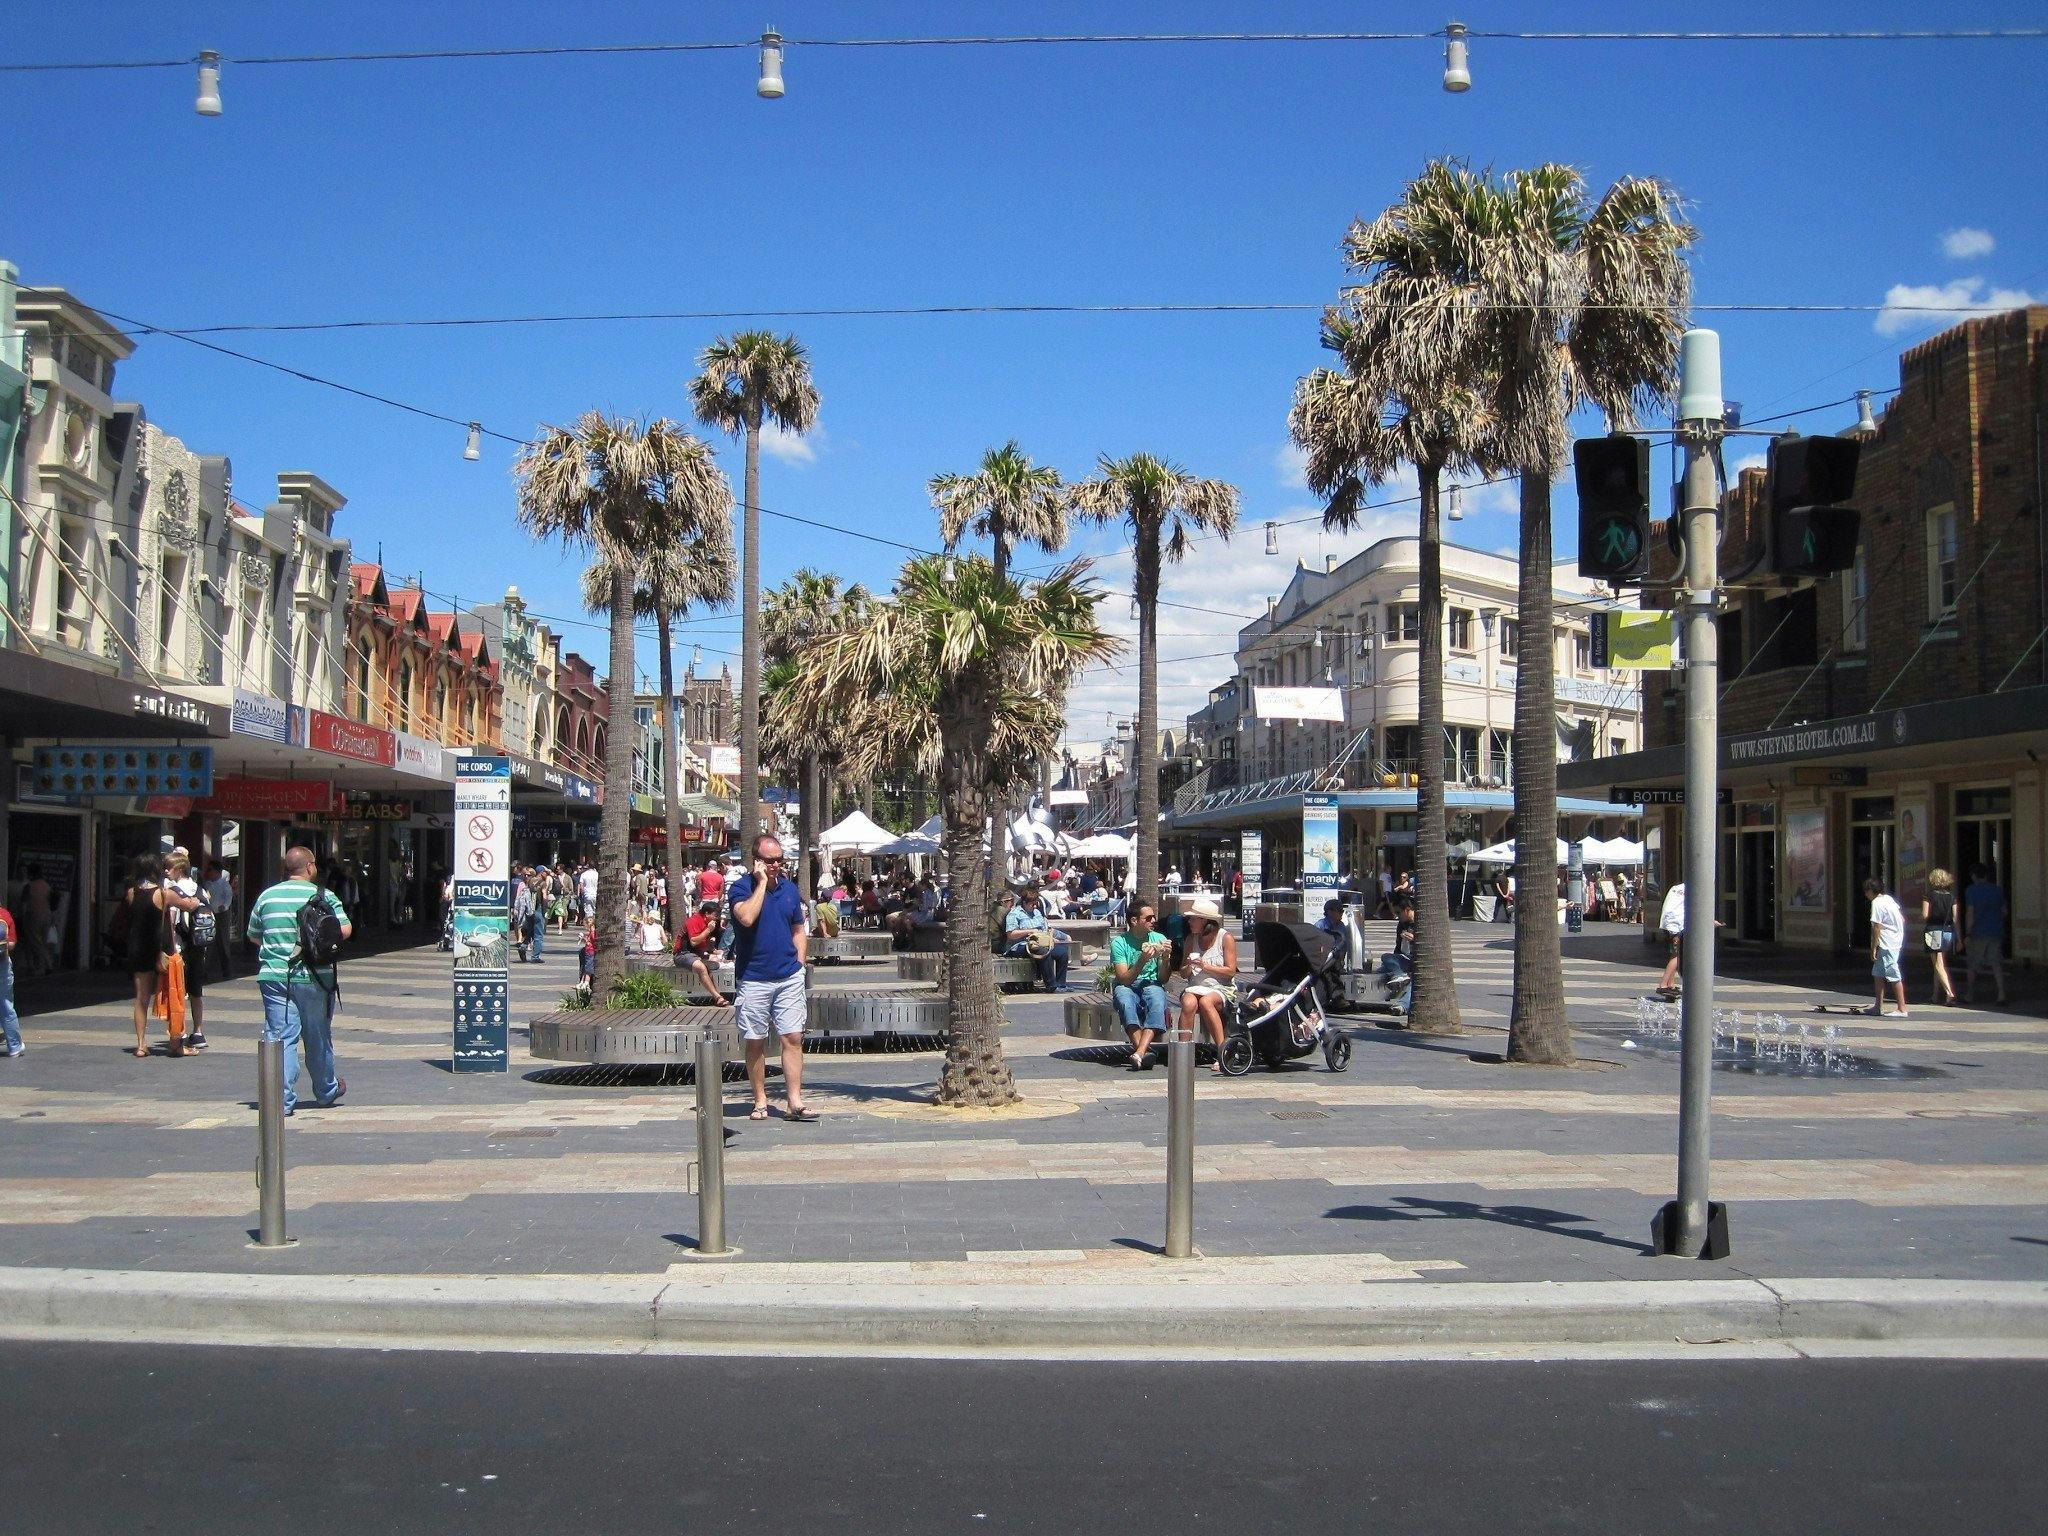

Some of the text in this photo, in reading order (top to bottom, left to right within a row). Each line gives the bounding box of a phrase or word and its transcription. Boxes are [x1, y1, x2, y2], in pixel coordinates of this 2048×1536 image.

[1576, 682, 1622, 705] BRIGHTON
[457, 762, 493, 772] THE CORSO
[1633, 791, 1683, 803] BOTTLE
[352, 803, 404, 819] BABS
[1305, 875, 1337, 885] manly
[457, 883, 505, 900] manly
